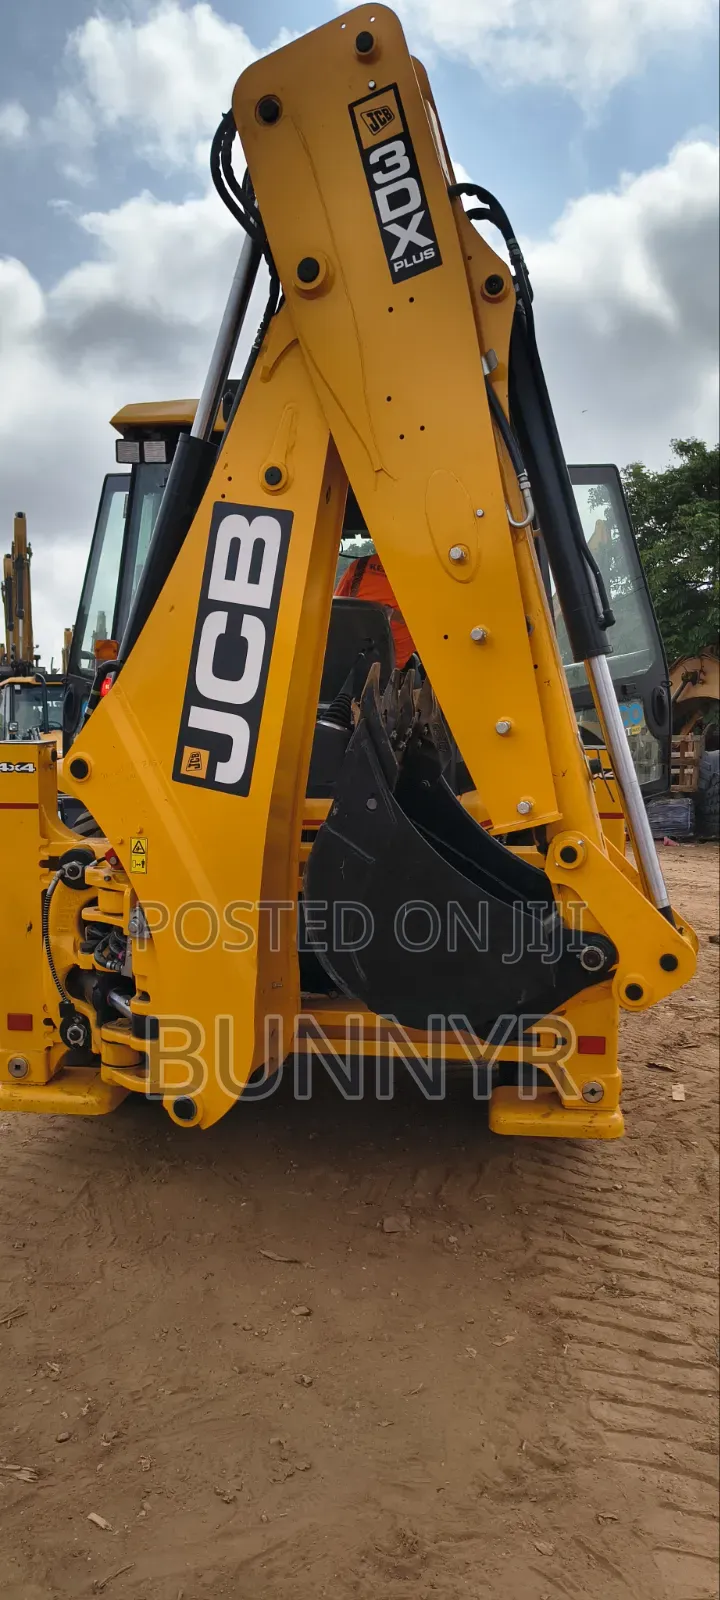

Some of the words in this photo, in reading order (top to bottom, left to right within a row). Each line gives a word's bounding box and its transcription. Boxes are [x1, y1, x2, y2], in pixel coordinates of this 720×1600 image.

[365, 106, 393, 133] JCB
[369, 139, 435, 261] 3DX
[393, 247, 435, 273] PLUS
[187, 513, 282, 785] JCB
[187, 751, 202, 770] JCB
